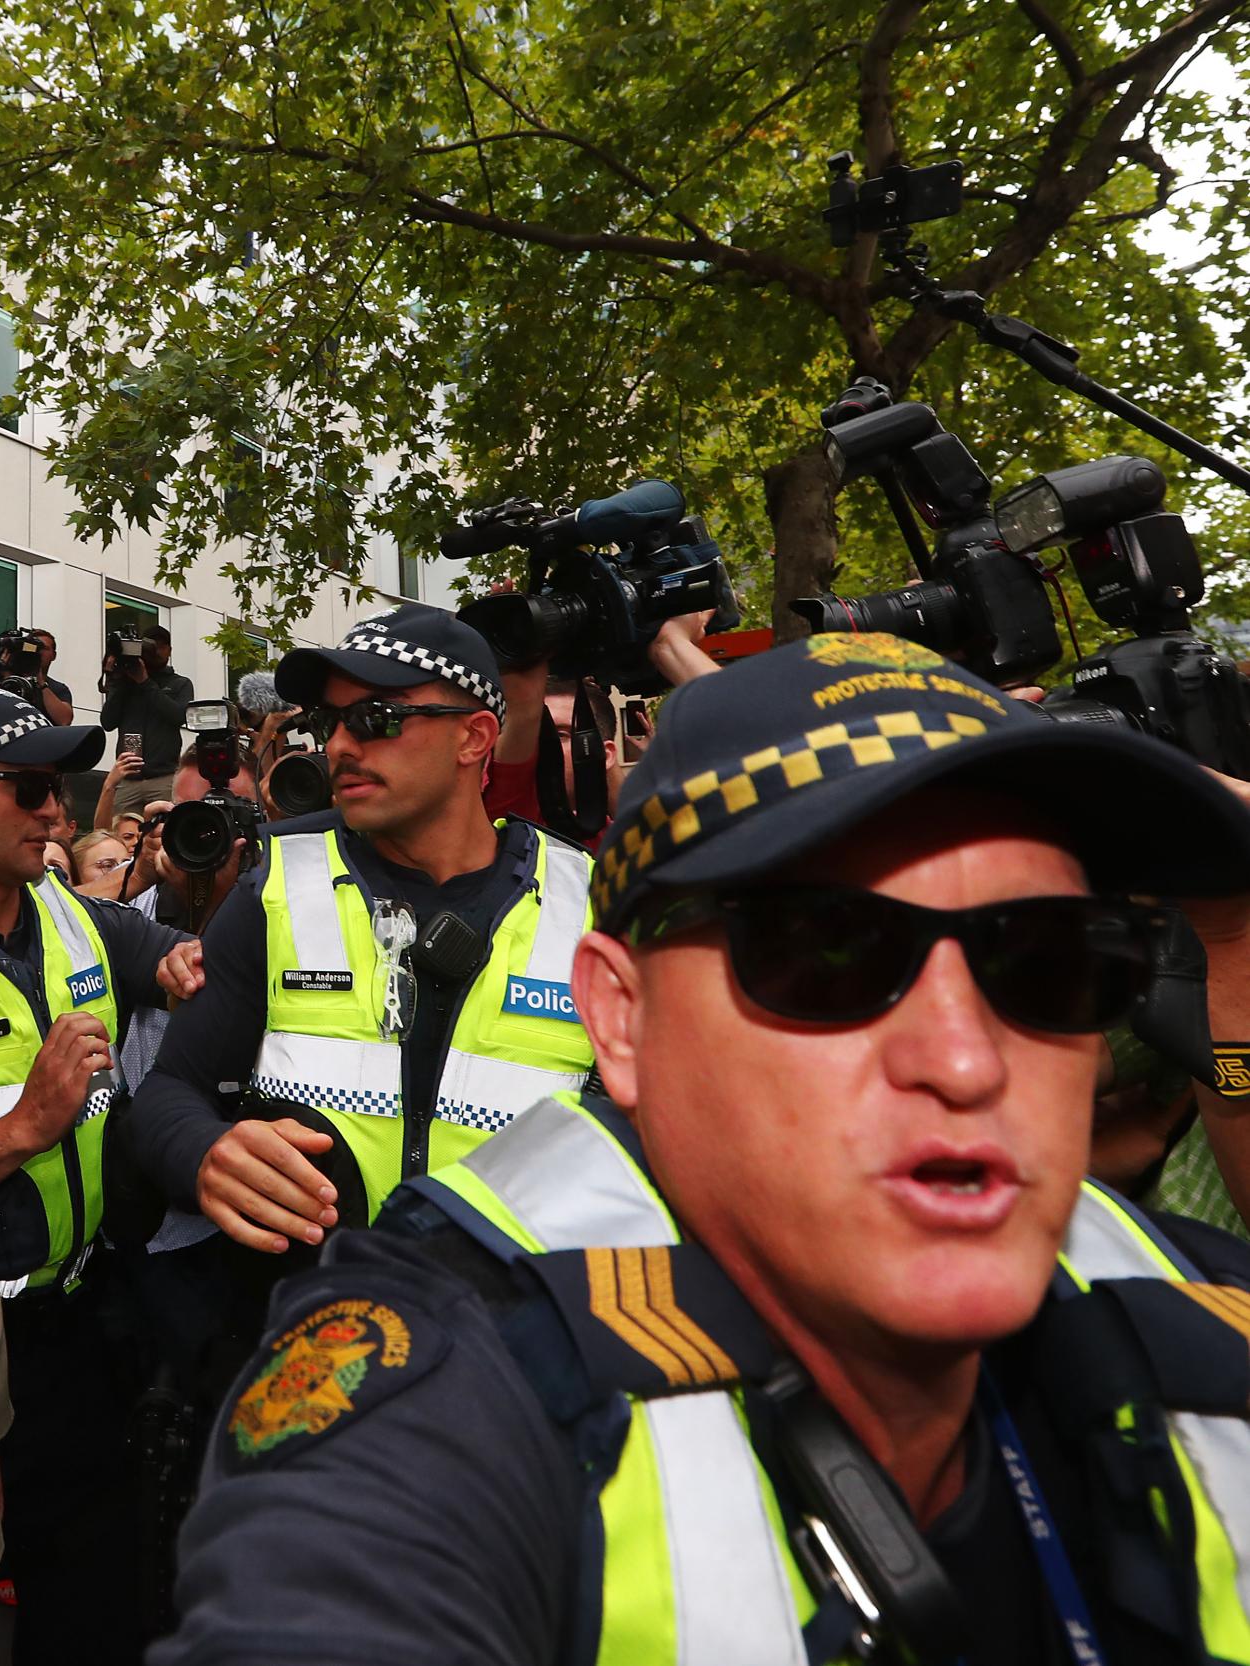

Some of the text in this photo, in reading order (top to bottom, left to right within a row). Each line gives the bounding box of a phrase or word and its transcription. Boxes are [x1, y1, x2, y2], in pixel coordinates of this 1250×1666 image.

[1075, 666, 1108, 684] Nikon
[284, 971, 351, 983] William Anderson
[301, 981, 332, 990] Constable
[510, 982, 580, 1015] Polic
